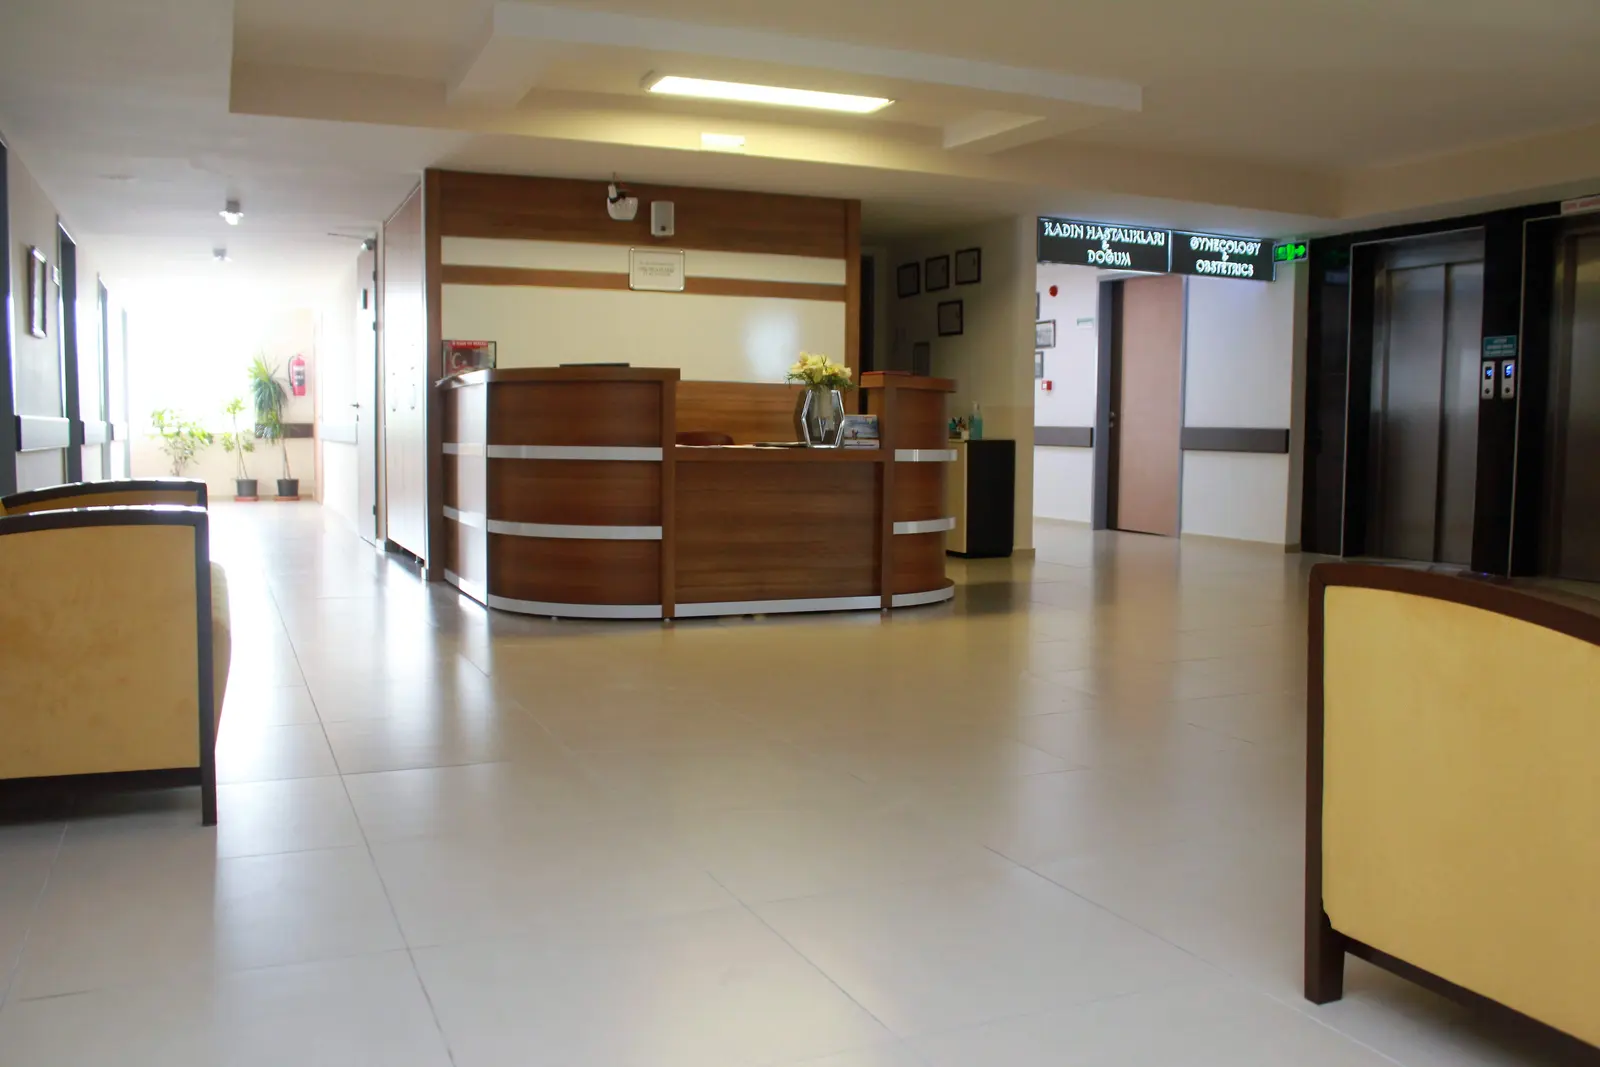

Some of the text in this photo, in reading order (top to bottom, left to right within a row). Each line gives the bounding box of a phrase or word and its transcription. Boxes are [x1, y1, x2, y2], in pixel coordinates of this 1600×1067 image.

[1044, 221, 1165, 246] KADIN HASTALIKLARI
[1101, 240, 1110, 250] &
[1190, 236, 1261, 256] GYNECOLOGY
[1087, 249, 1132, 267] DOĞUM
[1221, 252, 1230, 261] &
[1196, 259, 1254, 277] OBSTETRICS
